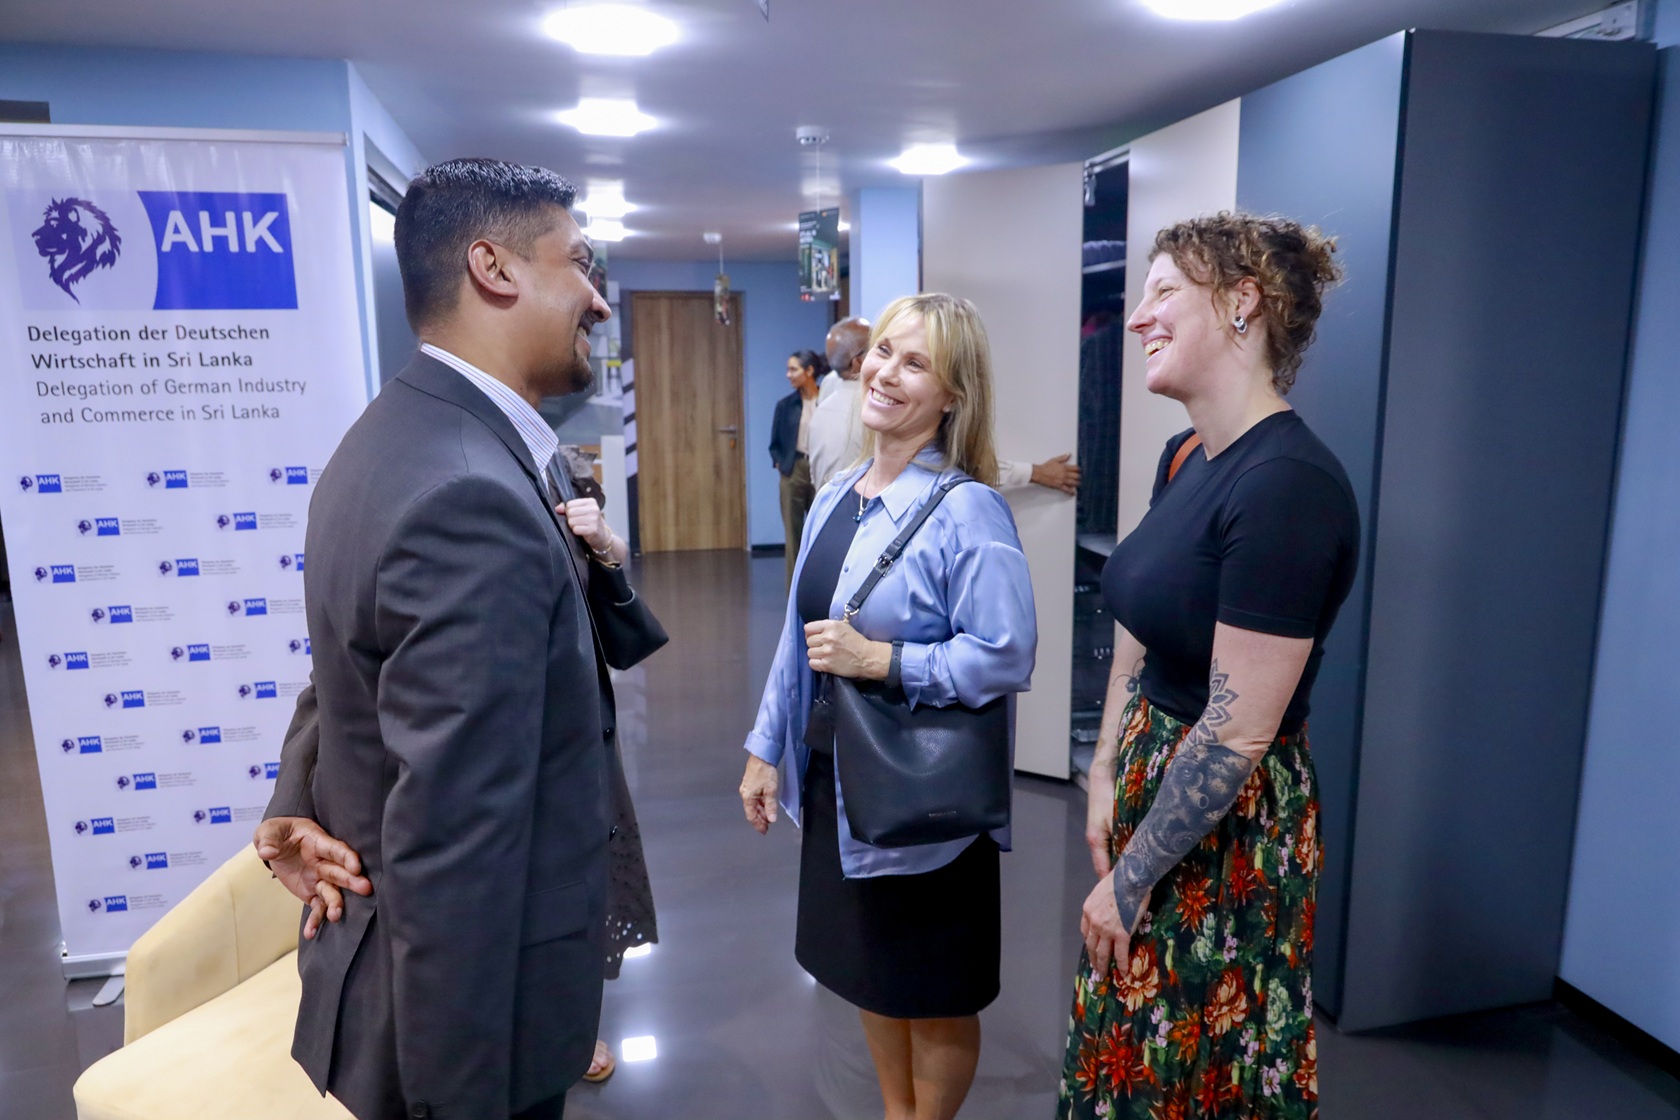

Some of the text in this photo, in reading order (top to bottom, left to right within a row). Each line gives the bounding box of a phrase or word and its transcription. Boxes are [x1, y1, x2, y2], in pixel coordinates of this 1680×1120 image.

[160, 210, 284, 253] AHK
[27, 324, 270, 345] Delegation der Deutschen
[31, 351, 253, 370] Wirtschaft in Sri Lanka
[36, 377, 307, 400] Delegation of German Industry
[40, 404, 281, 425] and Commerce in Sri Lanka
[165, 472, 187, 482] AHK
[287, 468, 307, 478] AHK
[39, 476, 60, 485] AHK
[97, 519, 119, 529] AHK
[235, 514, 256, 524] AHK
[178, 560, 199, 569] AHK
[53, 566, 74, 576] AHK
[246, 600, 267, 609] AHK
[110, 607, 132, 617] AHK
[188, 645, 210, 655] AHK
[66, 653, 88, 663] AHK
[256, 683, 276, 692] AHK
[123, 692, 144, 701] AHK
[200, 728, 221, 737] AHK
[79, 737, 101, 747] AHK
[134, 774, 155, 783] AHK
[211, 808, 231, 817] AHK
[93, 818, 114, 828] AHK
[147, 853, 168, 863] AHK
[106, 896, 127, 906] AHK
